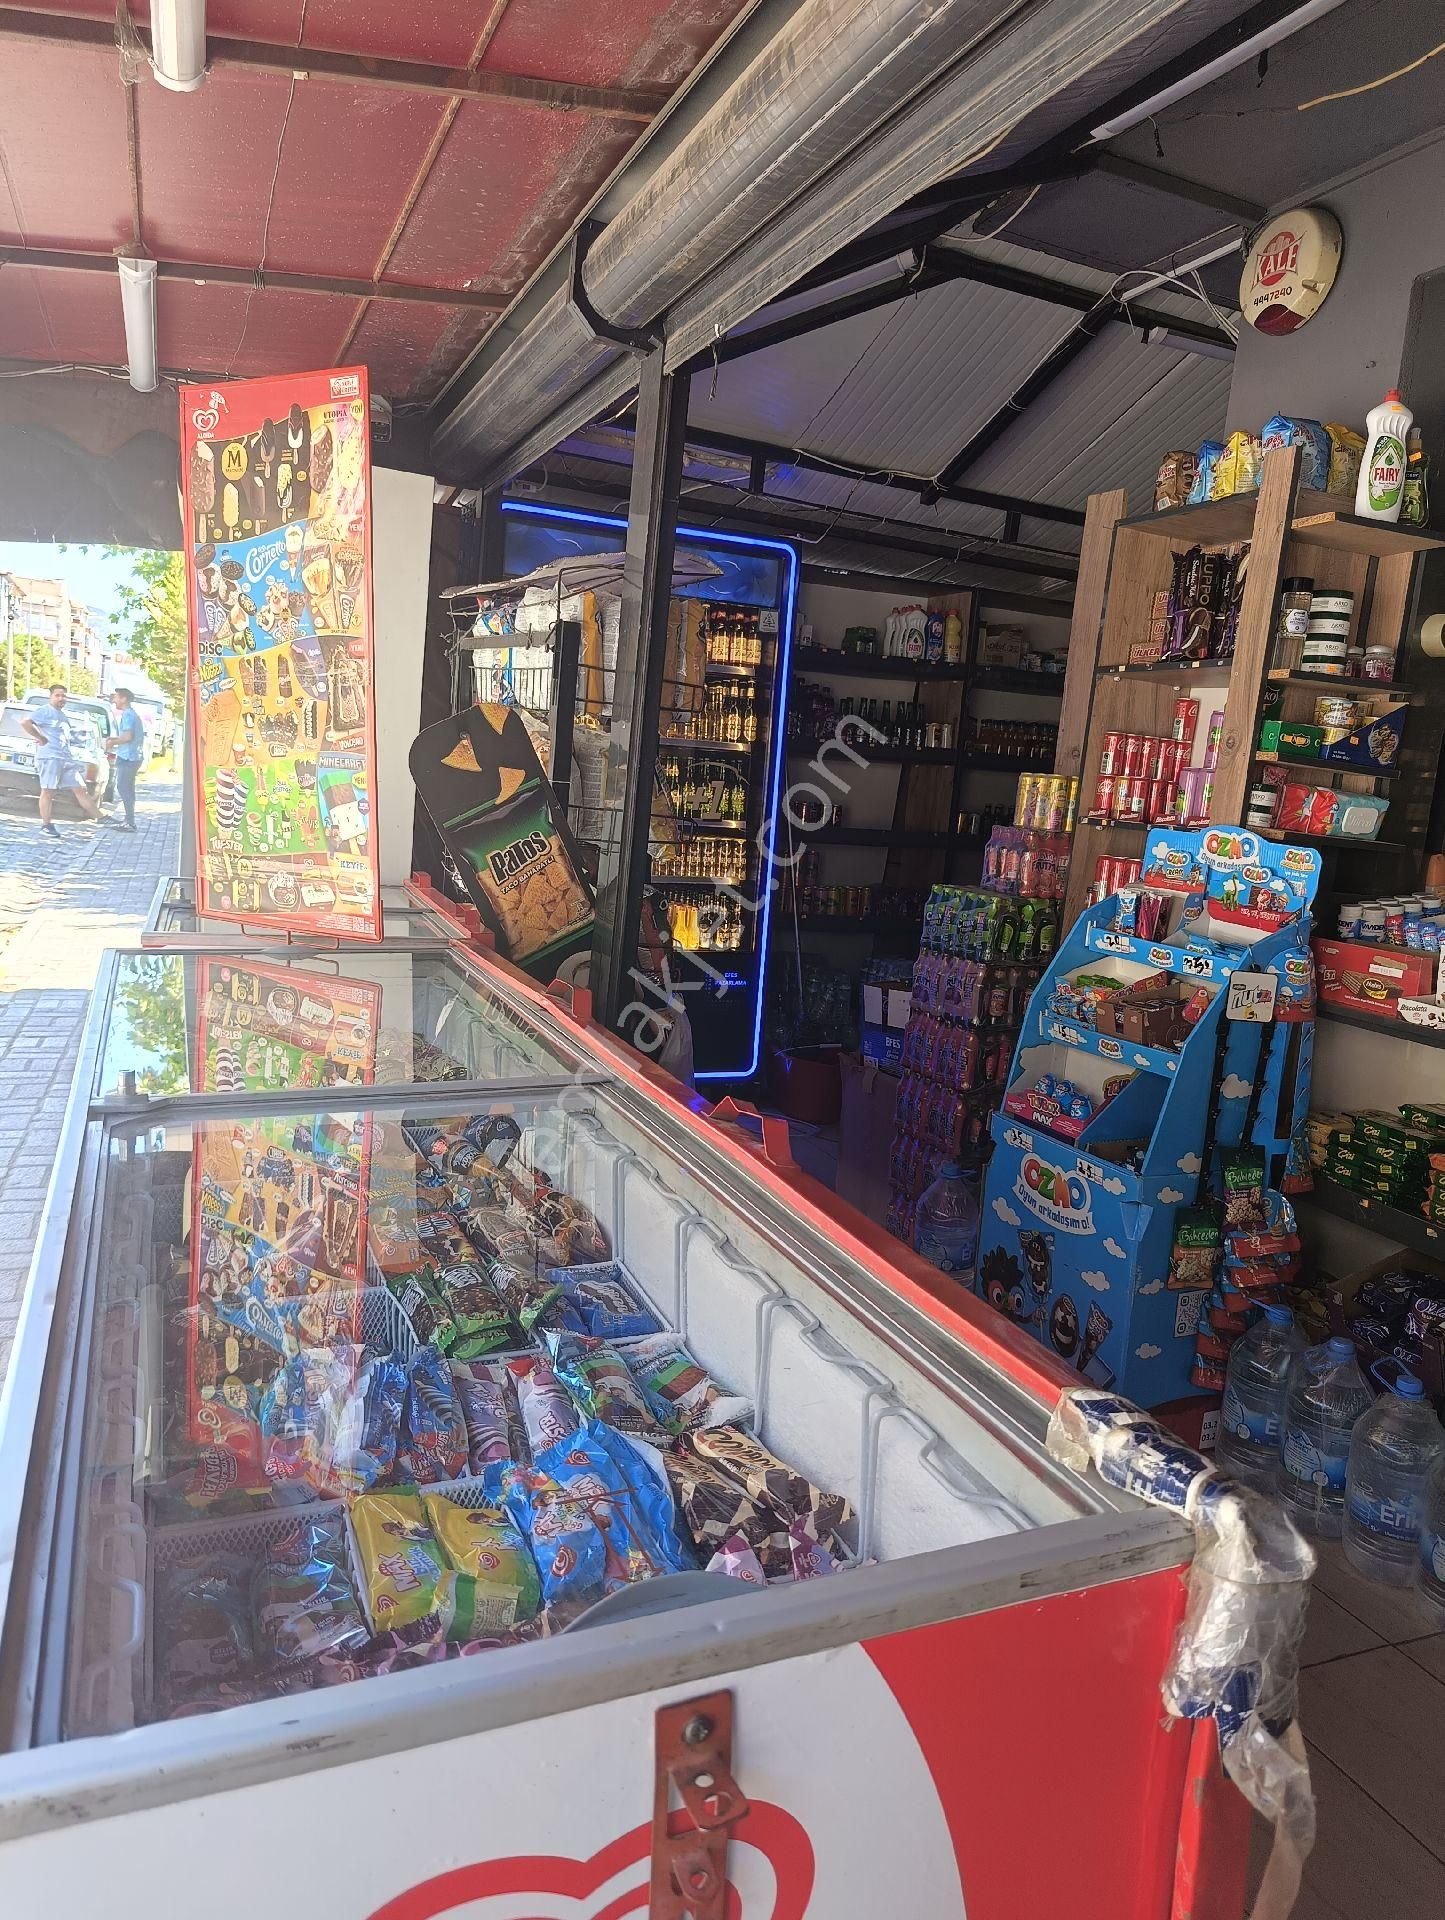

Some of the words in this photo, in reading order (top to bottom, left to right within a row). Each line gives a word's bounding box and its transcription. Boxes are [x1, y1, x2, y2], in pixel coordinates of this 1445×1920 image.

[1255, 243, 1300, 287] KALE
[1253, 286, 1293, 307] 4447240
[1373, 465, 1402, 483] FAIRY
[245, 541, 286, 583] Cornetto
[319, 756, 366, 770] MINECRAFT
[500, 881, 520, 896] TACO
[518, 854, 556, 883] BAHARATLI
[1032, 1111, 1053, 1126] MAX
[1023, 1157, 1087, 1211] OZMO
[1018, 1183, 1037, 1207] Oyun
[1037, 1203, 1081, 1229] arkadaşım
